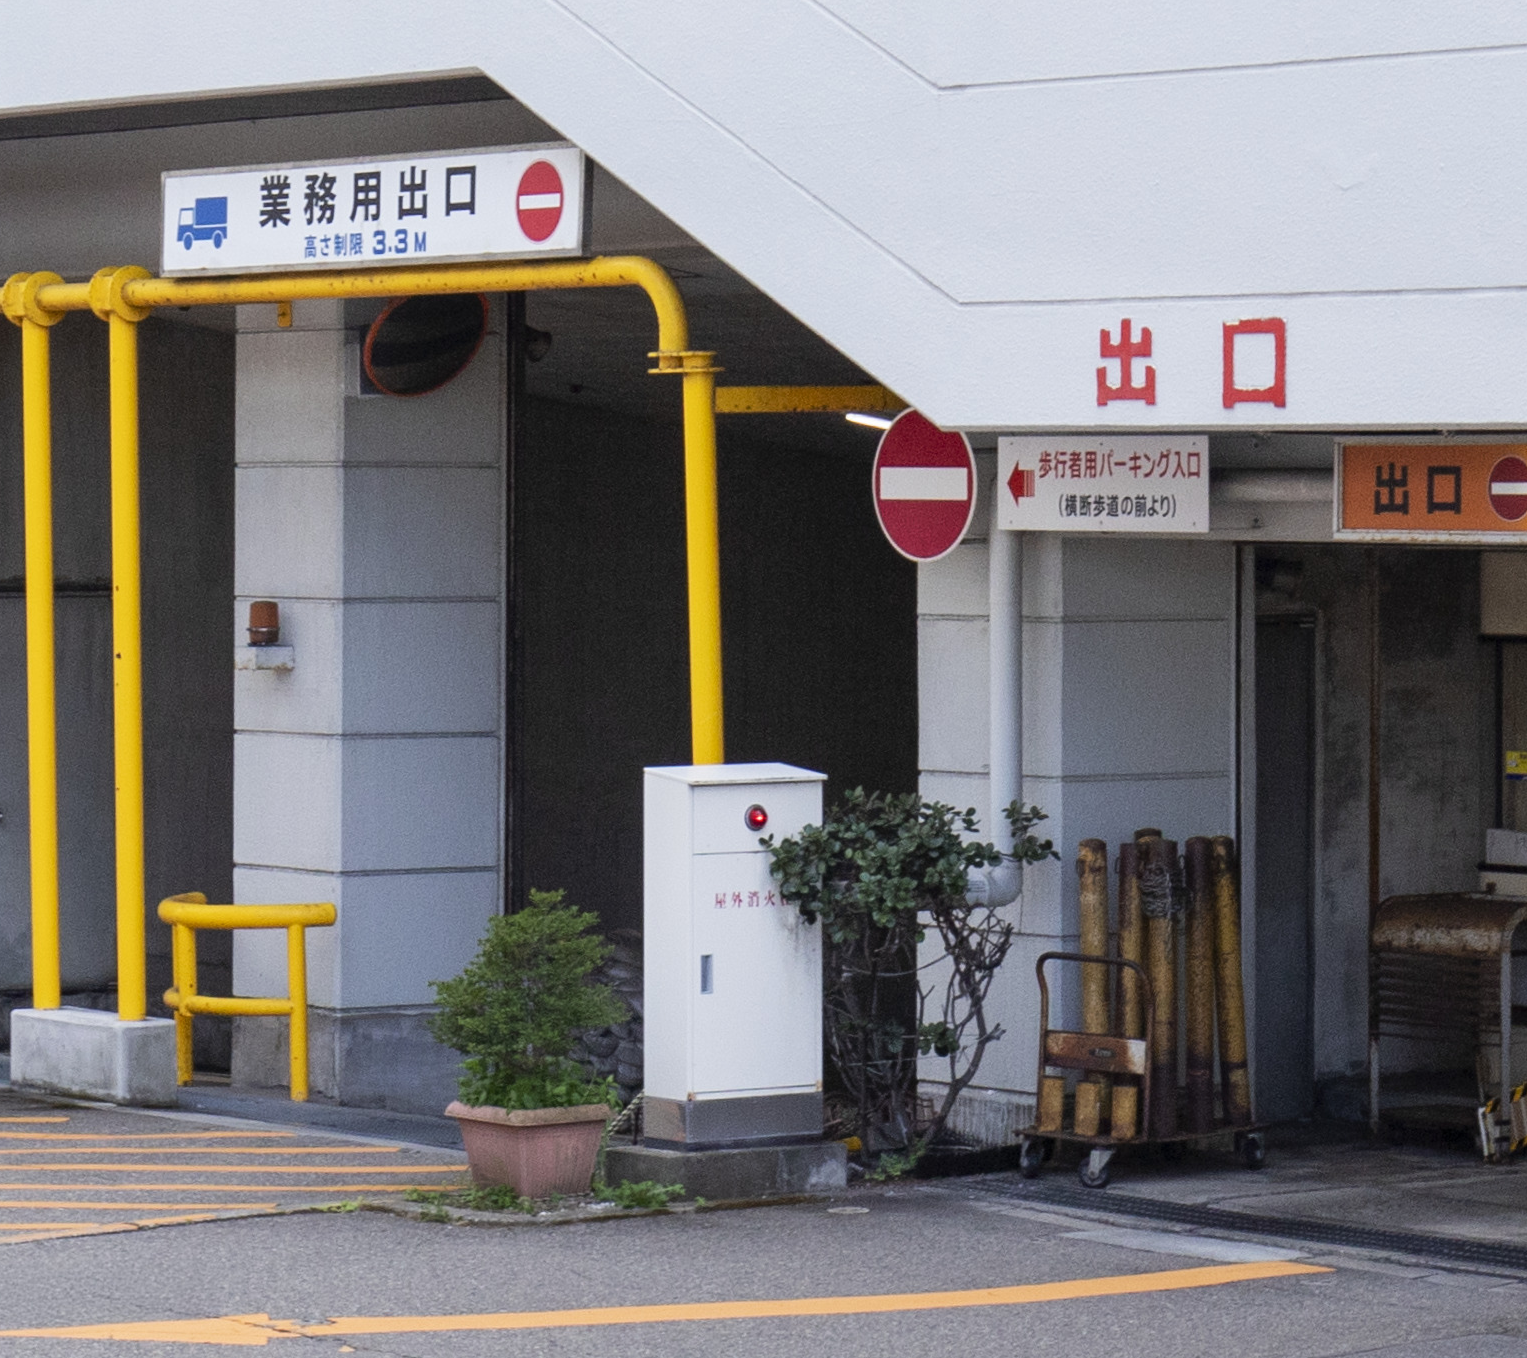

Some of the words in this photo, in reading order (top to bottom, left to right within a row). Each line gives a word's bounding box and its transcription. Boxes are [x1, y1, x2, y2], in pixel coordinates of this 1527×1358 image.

[259, 165, 477, 228] 業務用出口
[304, 233, 363, 258] 高さ制限
[1096, 317, 1287, 409] 出口
[1038, 448, 1201, 479] 歩行者用パーキング入口
[1058, 493, 1177, 518] (横断歩道の前より)
[1374, 463, 1462, 516] 出口
